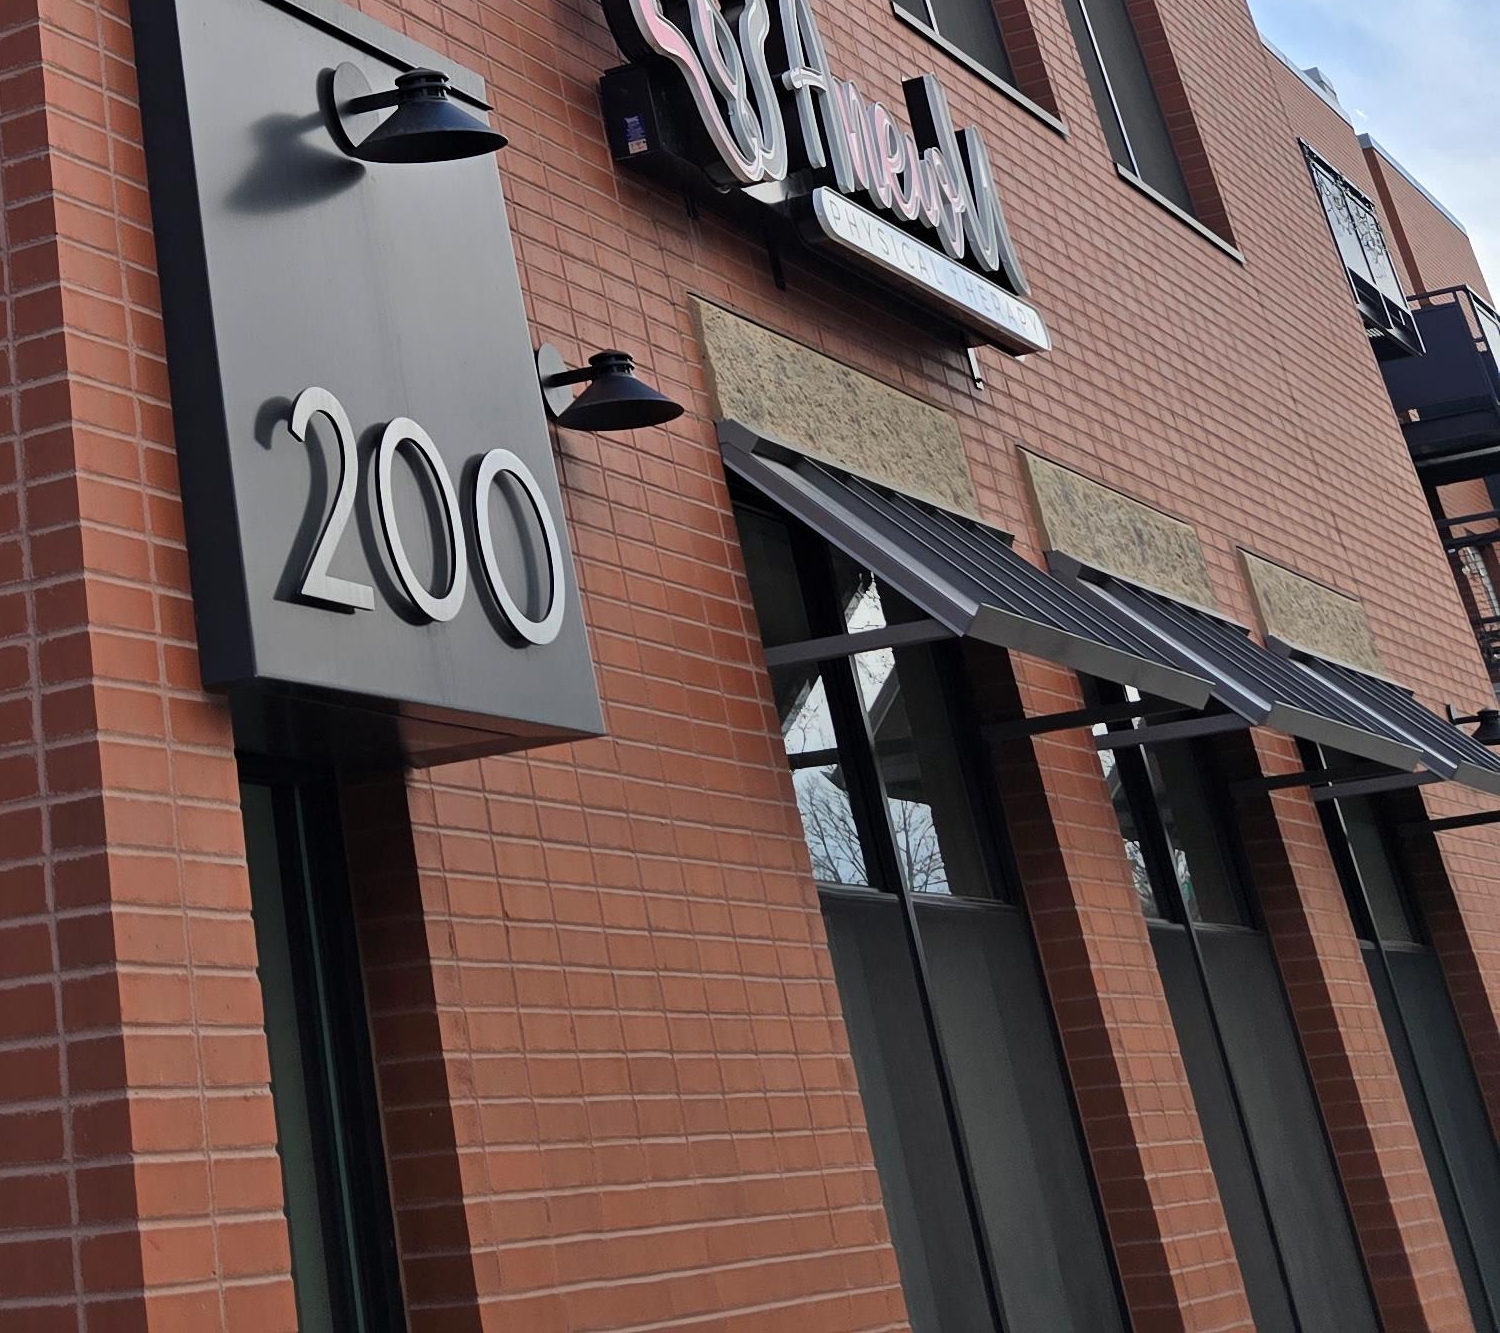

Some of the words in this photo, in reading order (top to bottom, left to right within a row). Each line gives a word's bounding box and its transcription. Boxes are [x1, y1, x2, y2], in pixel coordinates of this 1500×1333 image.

[828, 199, 943, 286] PHYSICAL
[949, 267, 1041, 339] THERAPY
[288, 386, 565, 645] 200
